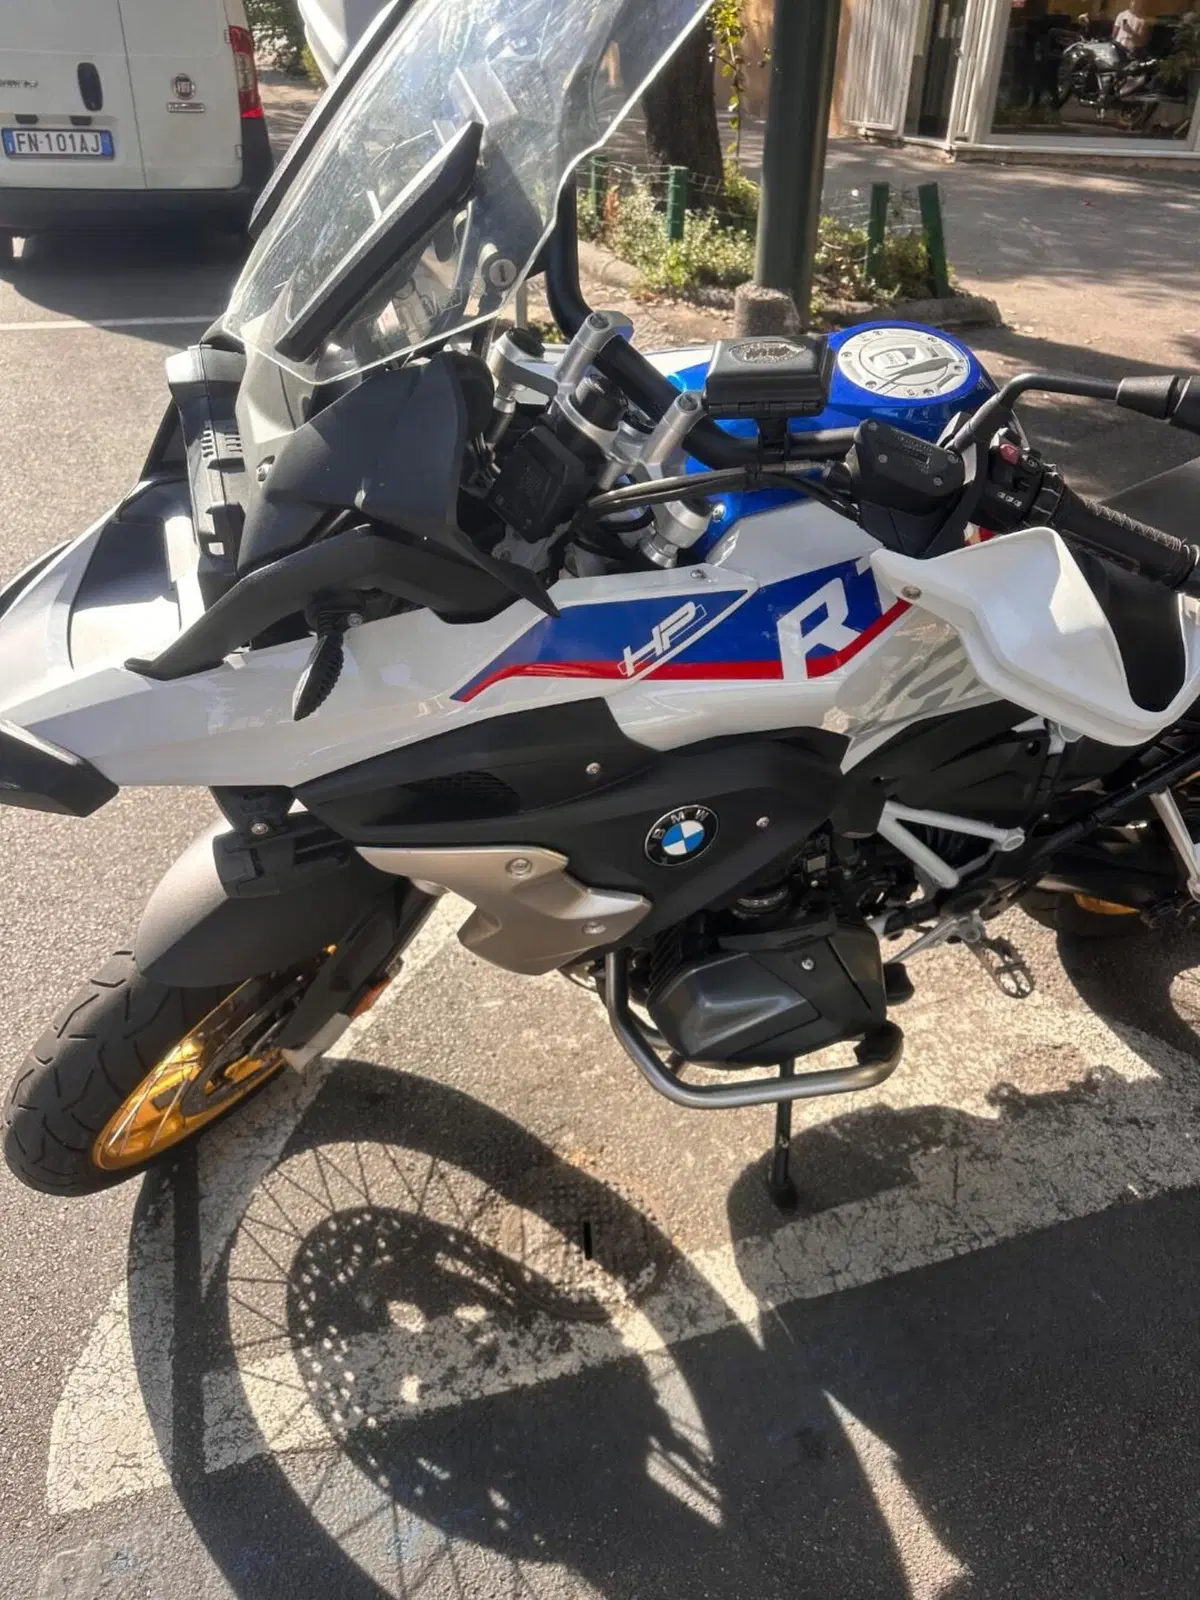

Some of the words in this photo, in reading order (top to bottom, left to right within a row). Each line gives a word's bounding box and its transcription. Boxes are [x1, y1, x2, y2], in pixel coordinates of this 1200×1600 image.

[617, 601, 703, 677] HP
[777, 577, 861, 680] R
[651, 809, 710, 839] BMW
